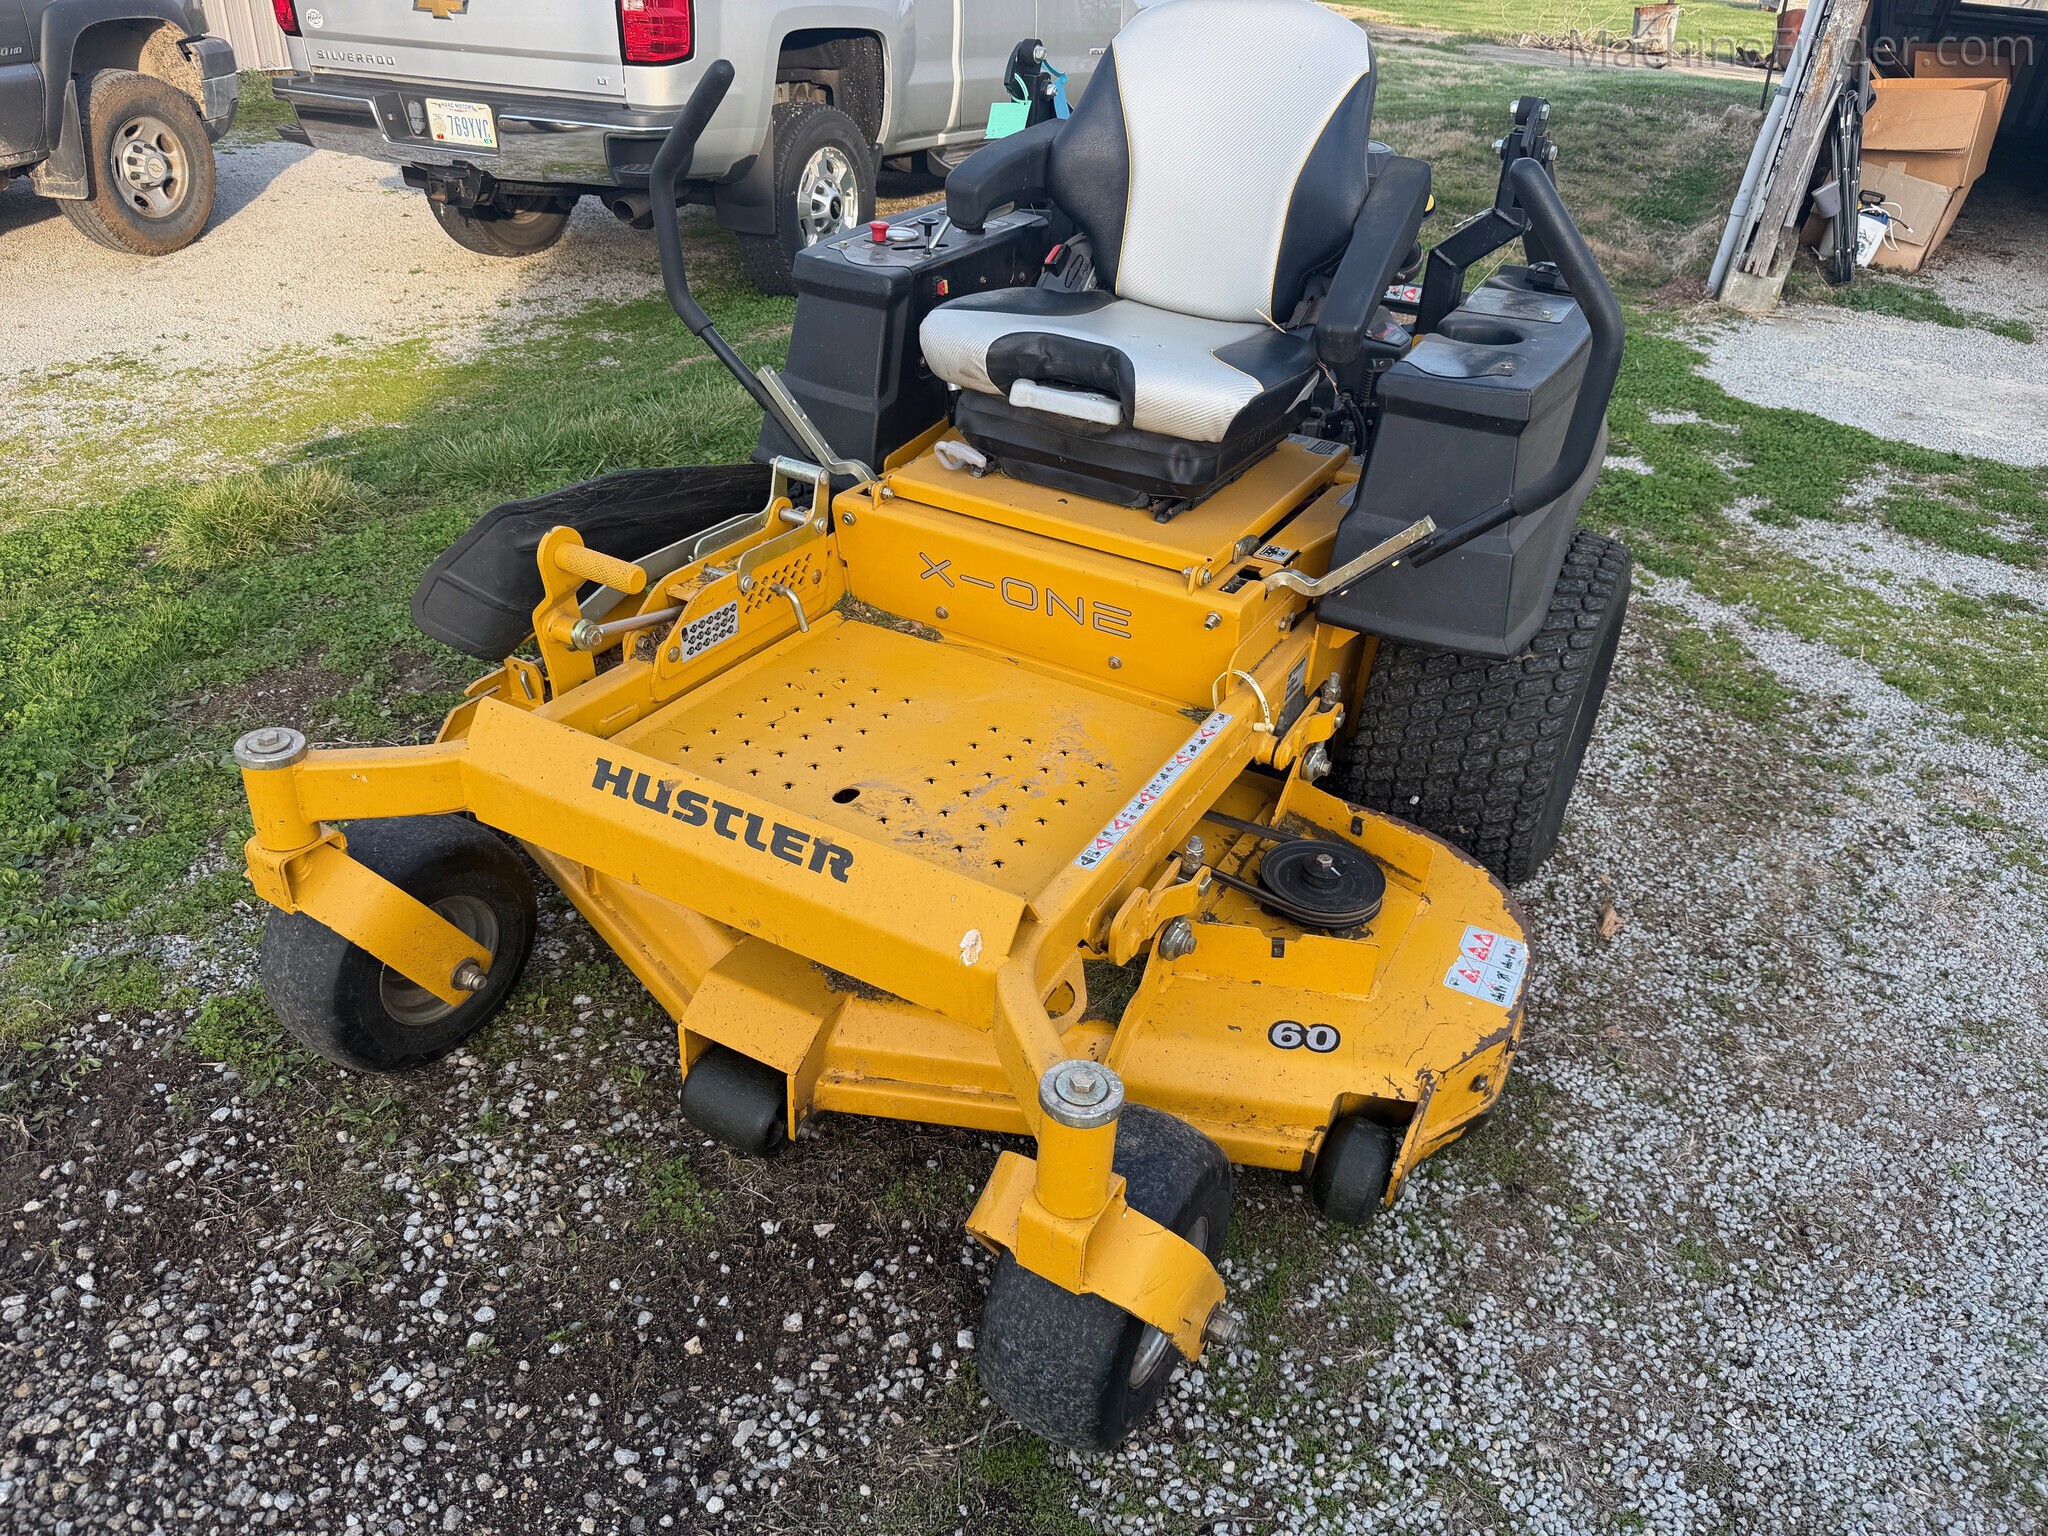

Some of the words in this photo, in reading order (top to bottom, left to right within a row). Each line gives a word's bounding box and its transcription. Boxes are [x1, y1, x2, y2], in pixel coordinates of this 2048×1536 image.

[317, 50, 396, 65] SILVERADO
[447, 115, 490, 138] 769YVC
[919, 552, 1132, 638] X-ONE
[592, 757, 854, 884] HUSTLER
[1268, 1020, 1341, 1053] 60
